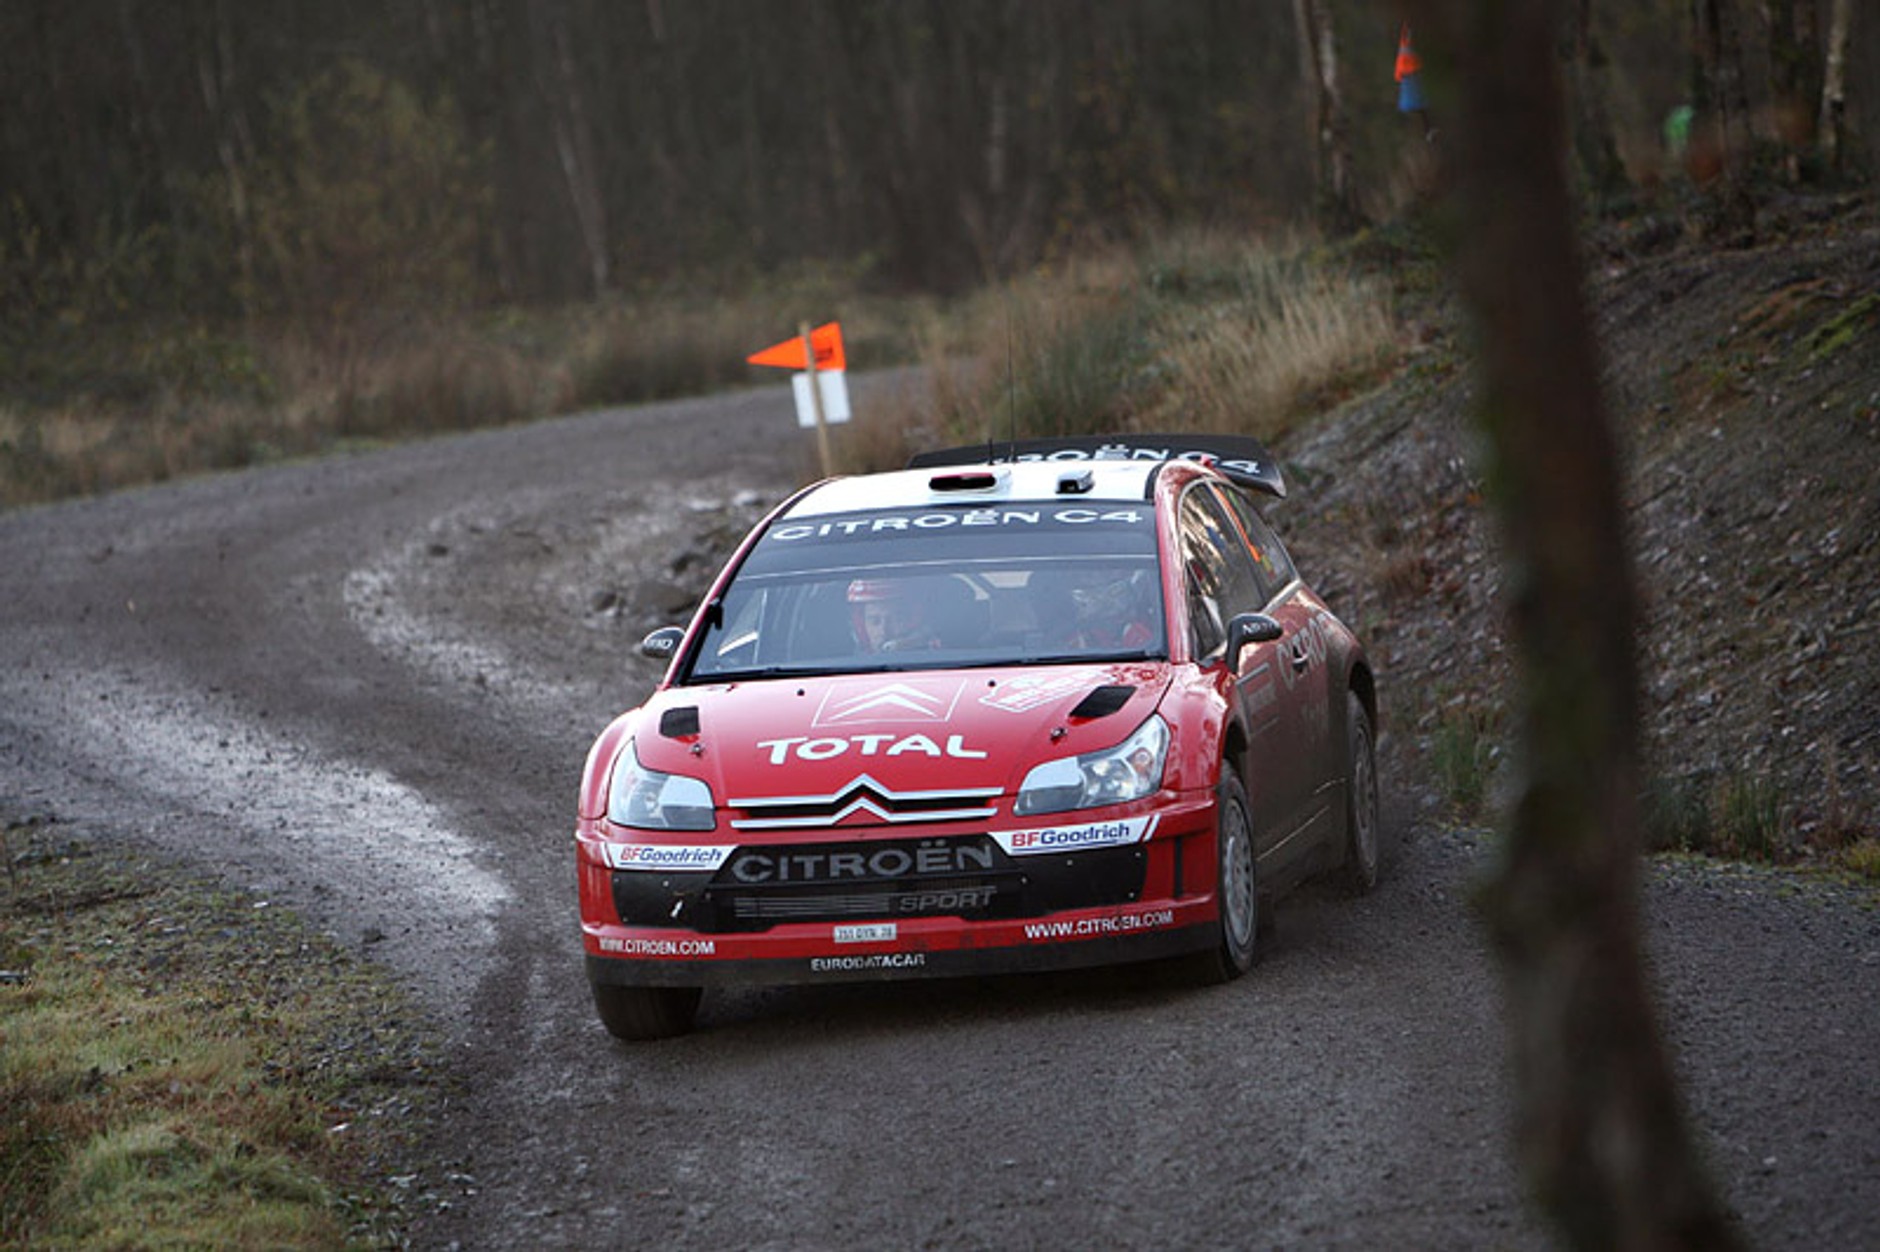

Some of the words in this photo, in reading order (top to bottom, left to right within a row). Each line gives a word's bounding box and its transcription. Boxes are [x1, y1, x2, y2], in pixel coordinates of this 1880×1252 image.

[771, 509, 1040, 541] CITROËN
[1053, 509, 1143, 524] C4
[756, 733, 988, 765] TOTAL
[1011, 823, 1130, 847] BFGoodrich
[620, 847, 722, 862] BFGoodrich
[731, 839, 994, 882] CITROËN
[900, 888, 996, 912] SPORT
[1025, 910, 1174, 938] WWW.CITROEN.COM
[811, 953, 925, 971] EURODATACAR
